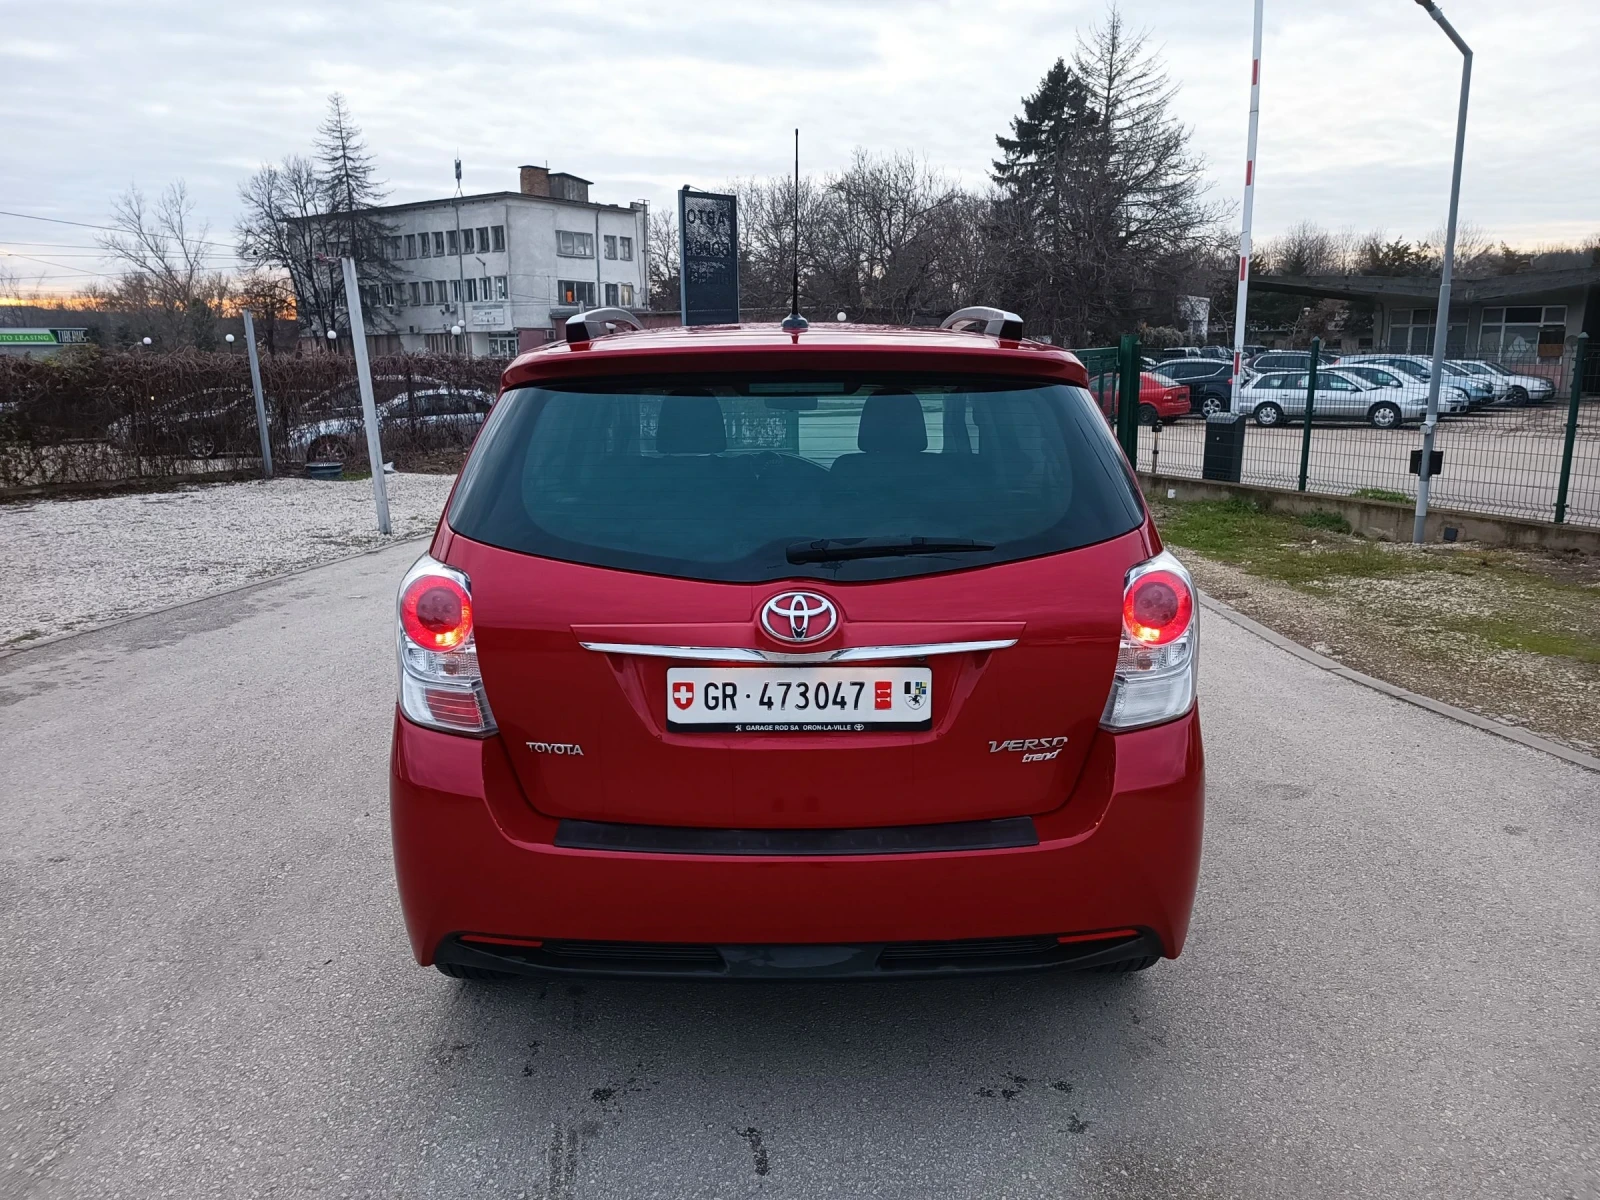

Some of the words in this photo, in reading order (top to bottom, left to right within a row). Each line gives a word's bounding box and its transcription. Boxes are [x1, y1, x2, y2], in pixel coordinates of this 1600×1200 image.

[525, 741, 585, 756] TOYOTA
[988, 736, 1069, 753] VERSO
[1021, 748, 1063, 763] trend
